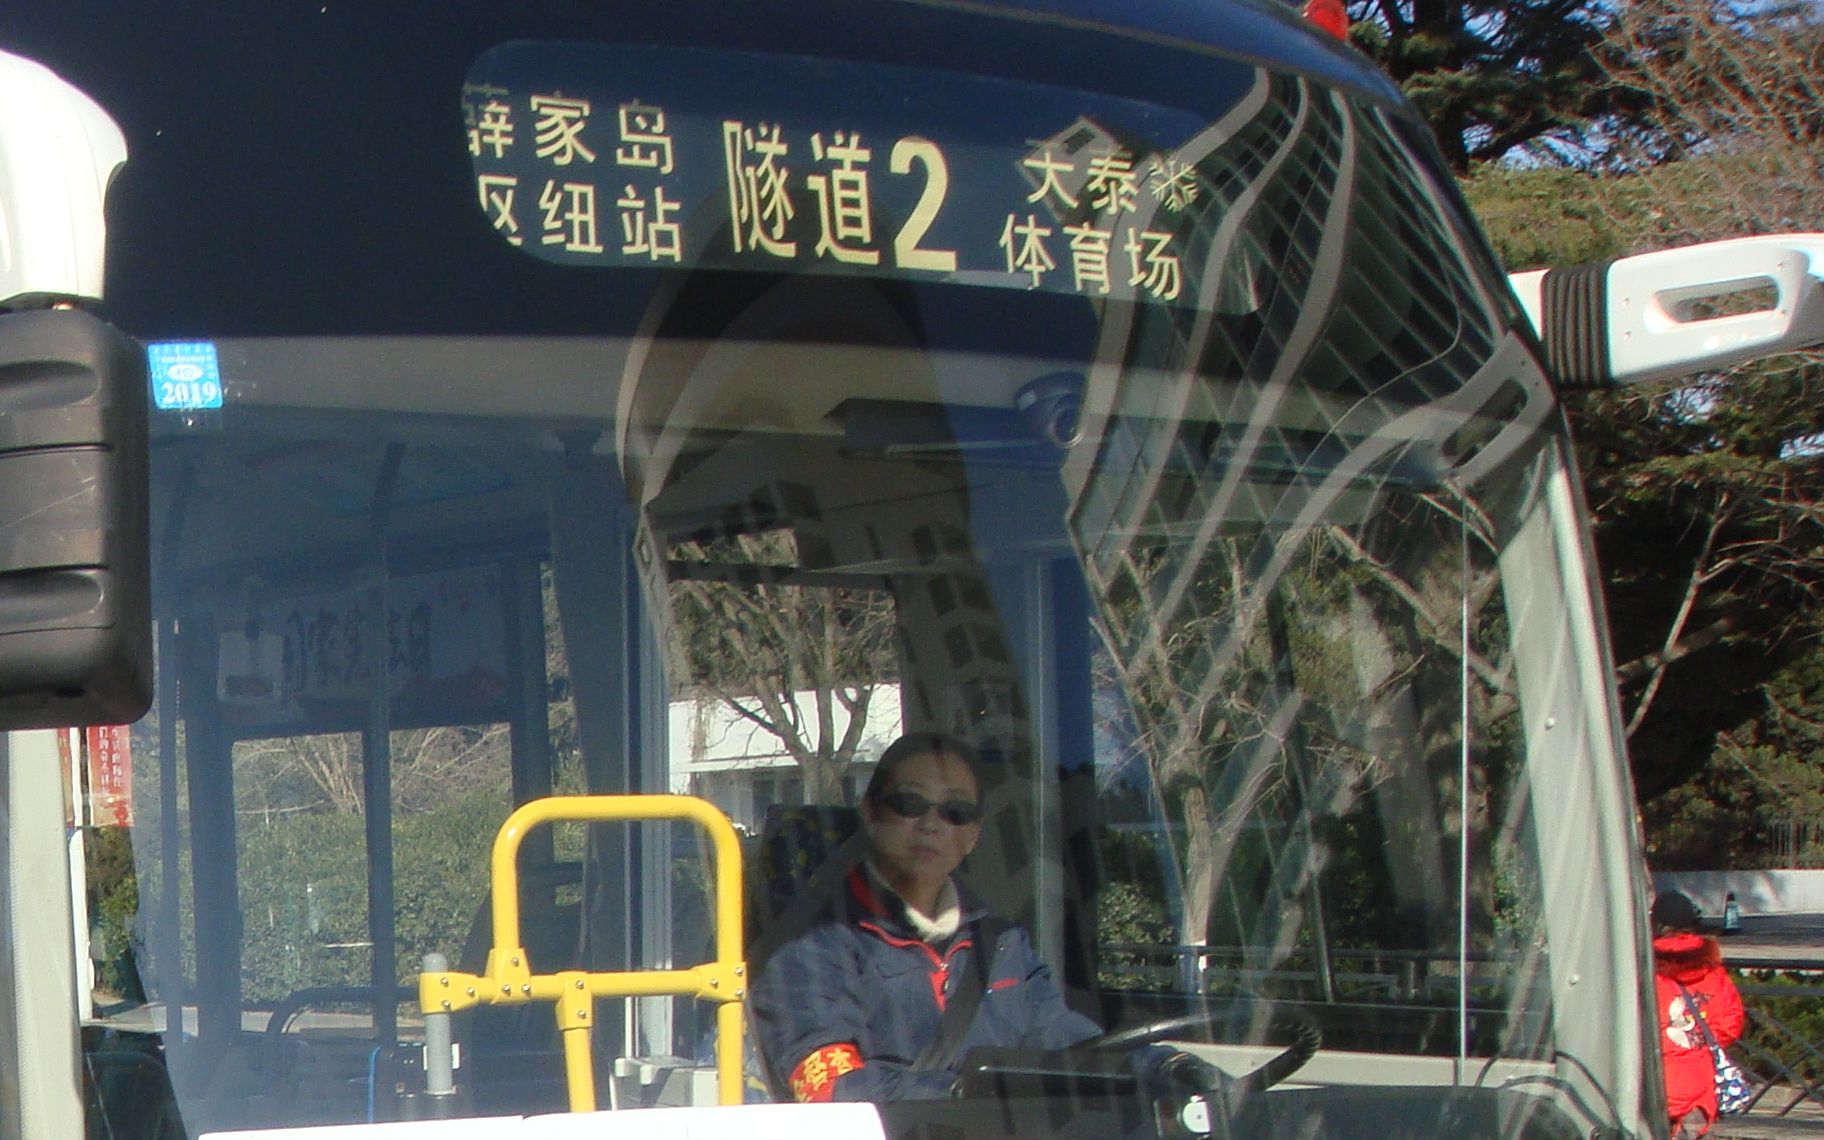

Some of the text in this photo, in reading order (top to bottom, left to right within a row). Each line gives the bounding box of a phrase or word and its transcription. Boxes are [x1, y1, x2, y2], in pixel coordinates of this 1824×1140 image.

[721, 117, 958, 272] 隧道2
[998, 213, 1182, 301] 体育场
[161, 381, 217, 405] 2019
